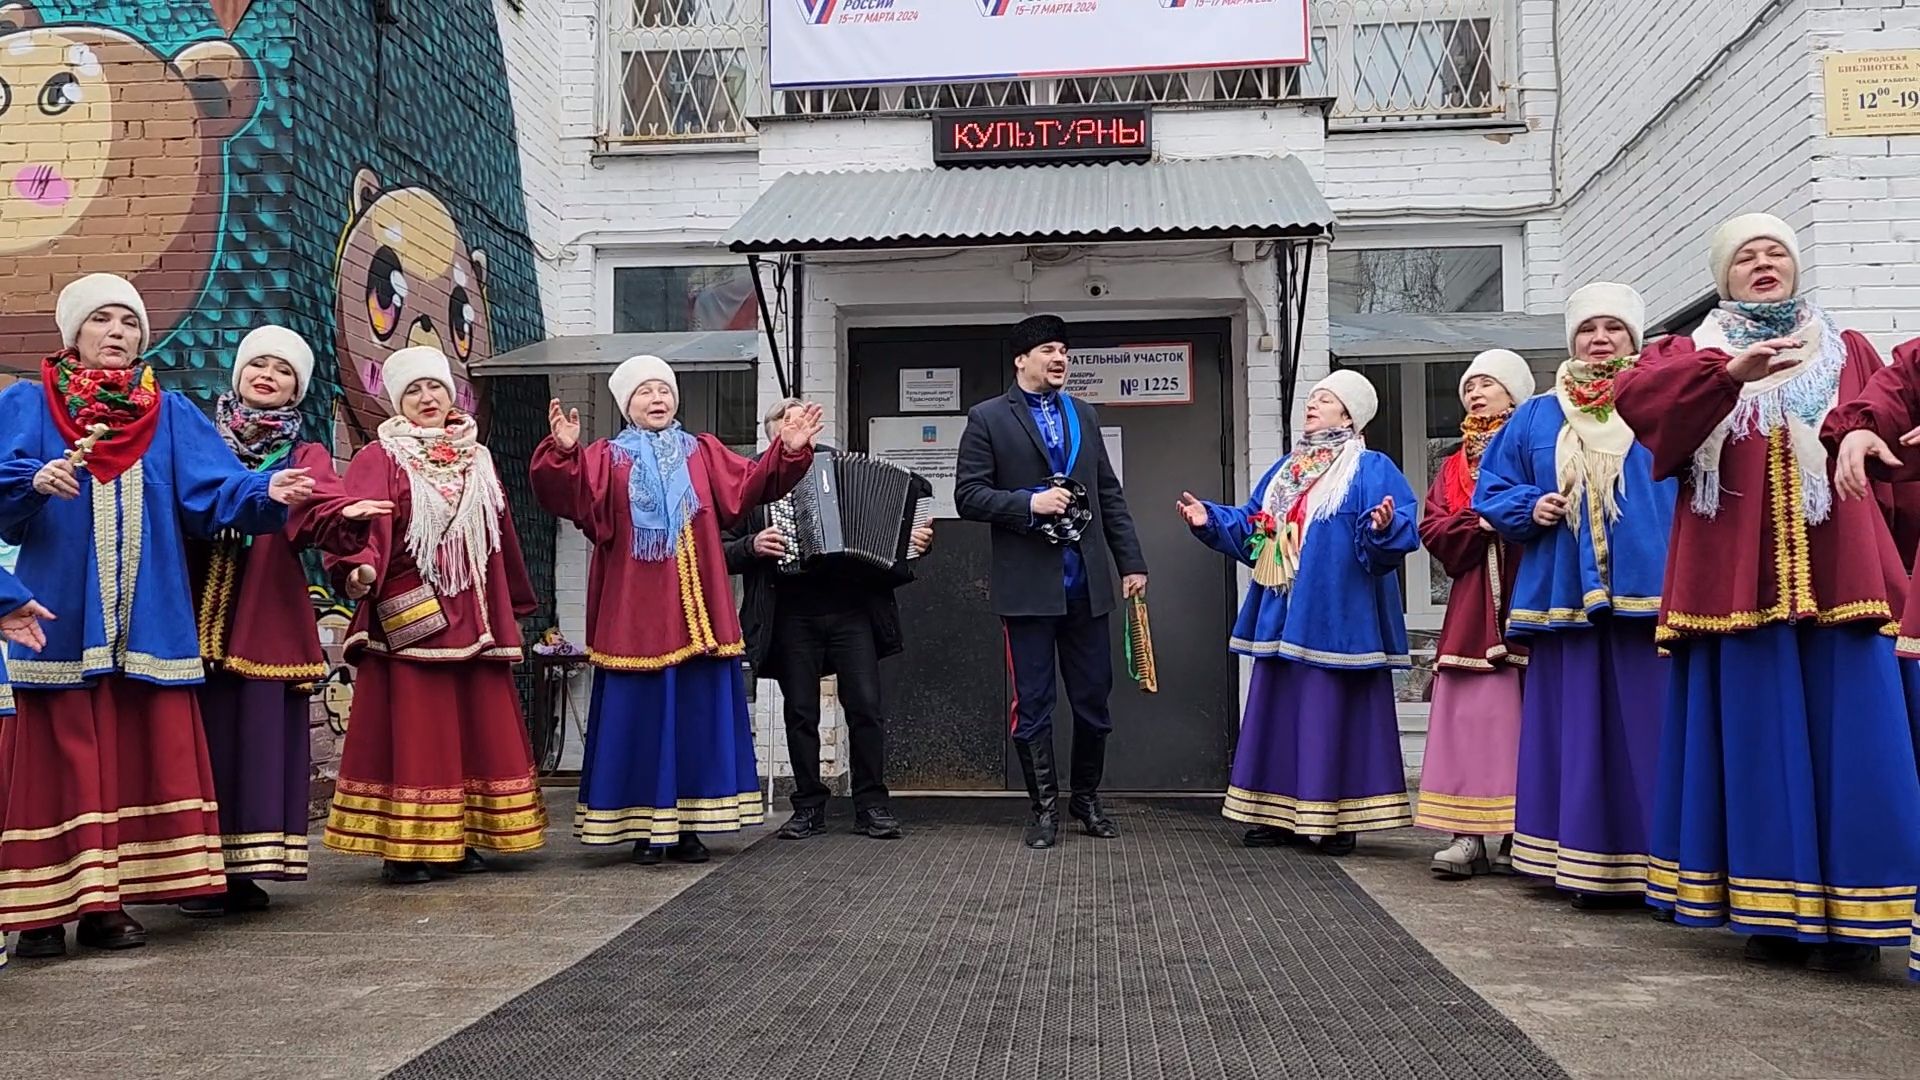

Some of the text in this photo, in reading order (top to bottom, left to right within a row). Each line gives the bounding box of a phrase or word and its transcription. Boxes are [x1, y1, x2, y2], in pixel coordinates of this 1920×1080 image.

[843, 0, 895, 10] РОССИИ
[1040, 3, 1072, 14] МАРТА
[1073, 1, 1097, 13] 2024
[864, 12, 895, 22] МАРТА
[896, 10, 919, 21] 2024
[1858, 55, 1907, 63] ГОРОДСКАЯ
[1838, 63, 1909, 73] БИБЛИОТЕКА
[954, 118, 1145, 150] КУЛЬТУРНЫ
[1066, 351, 1184, 365] РАТЕЛЬНЫЙ УЧАСТОК
[1120, 377, 1179, 396] № 1225
